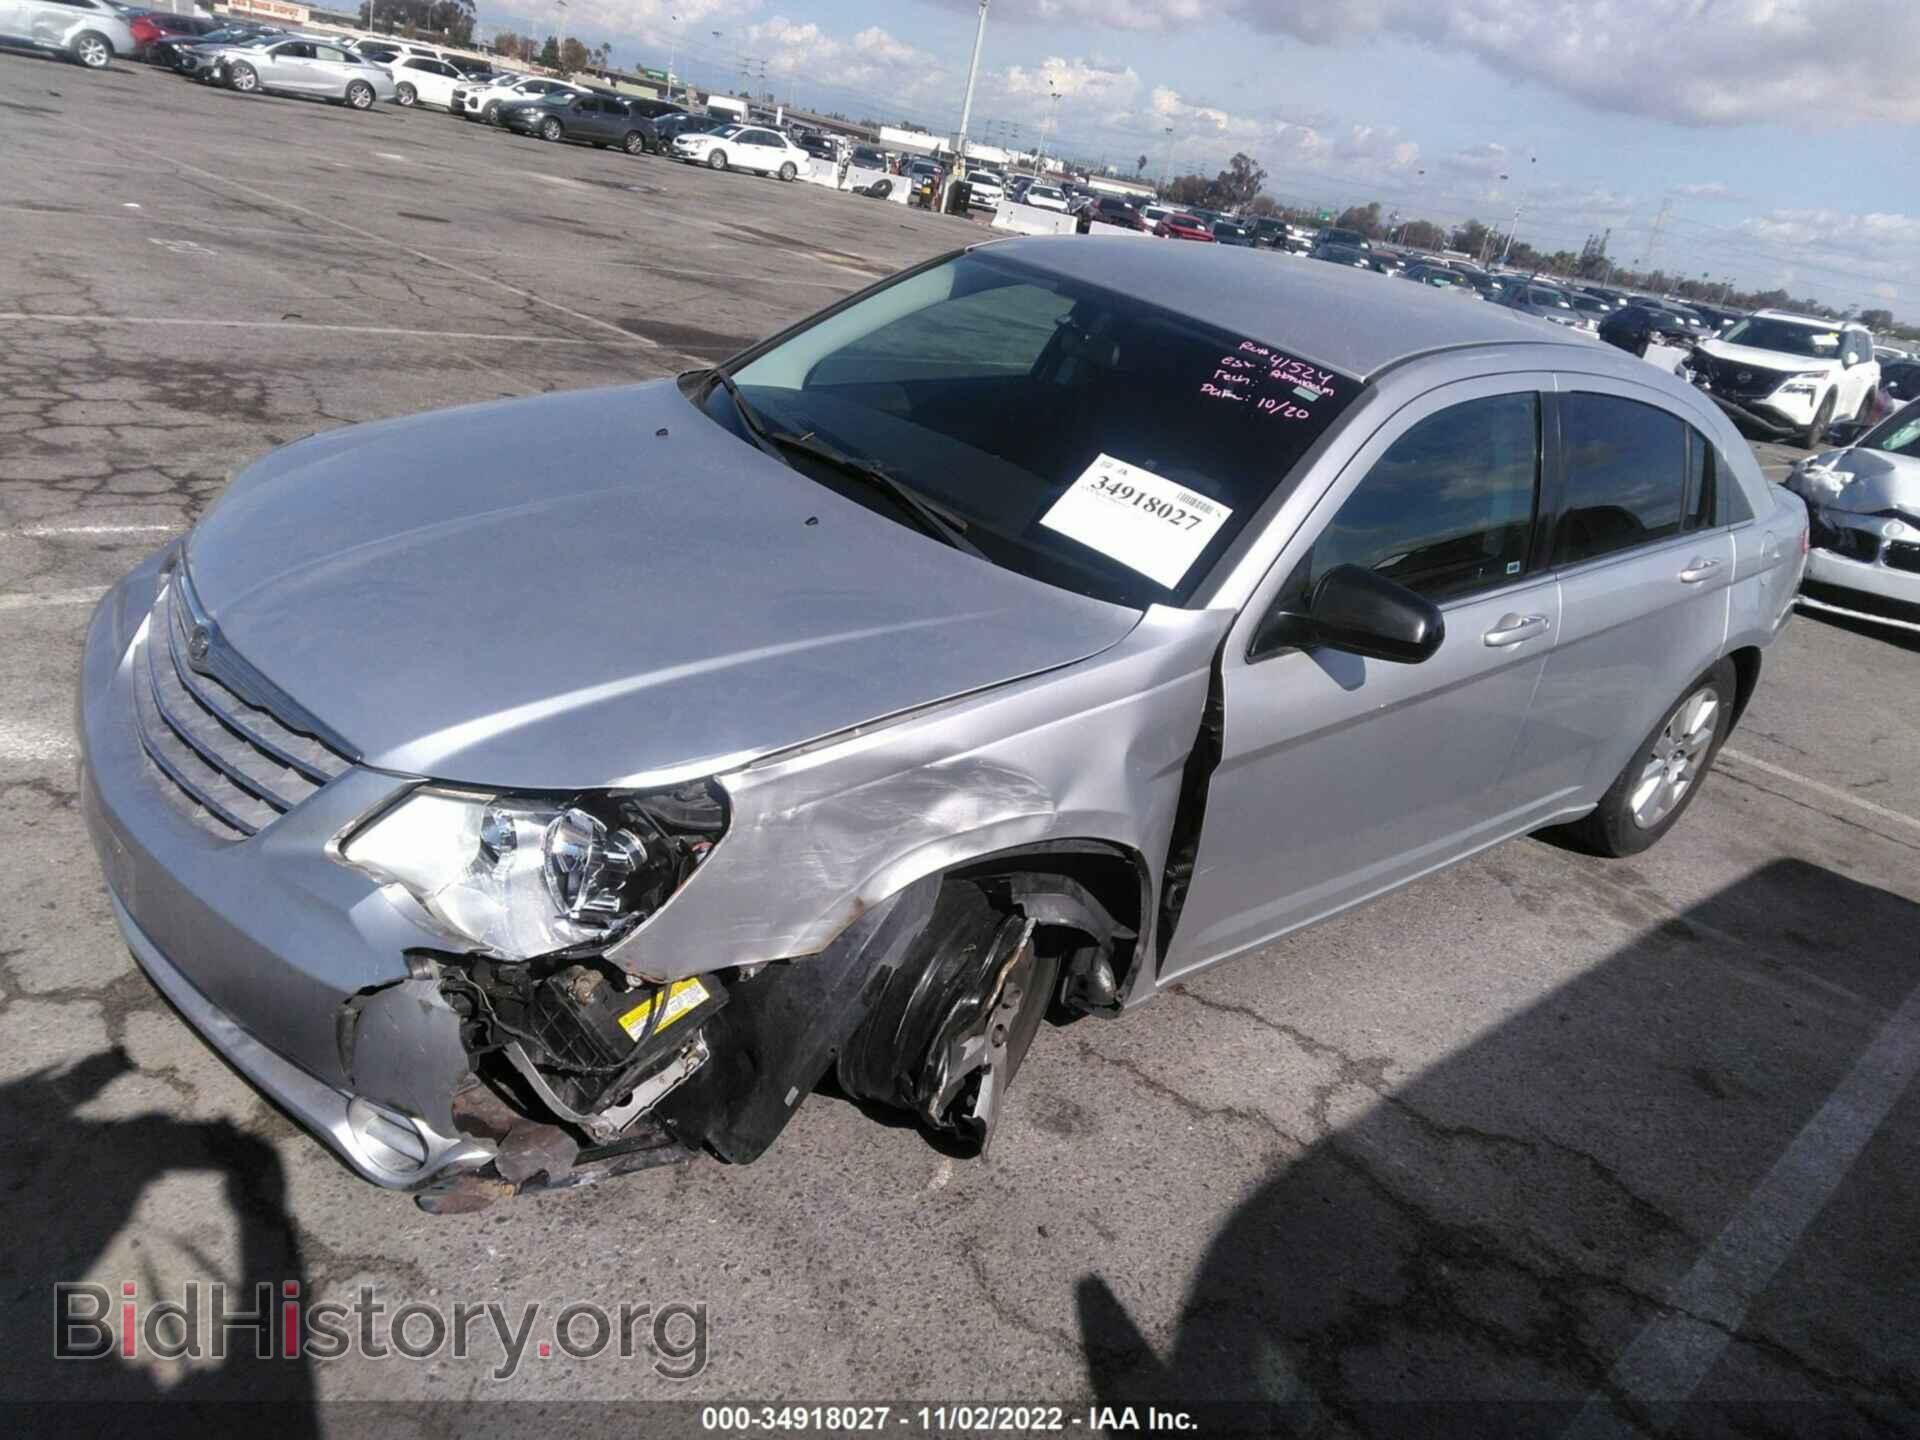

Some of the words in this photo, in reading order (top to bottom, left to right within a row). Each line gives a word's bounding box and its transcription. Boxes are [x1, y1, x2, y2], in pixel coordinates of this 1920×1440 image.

[1270, 354, 1334, 386] 41524
[1257, 397, 1310, 420] 10/20
[1091, 475, 1203, 531] 34918027
